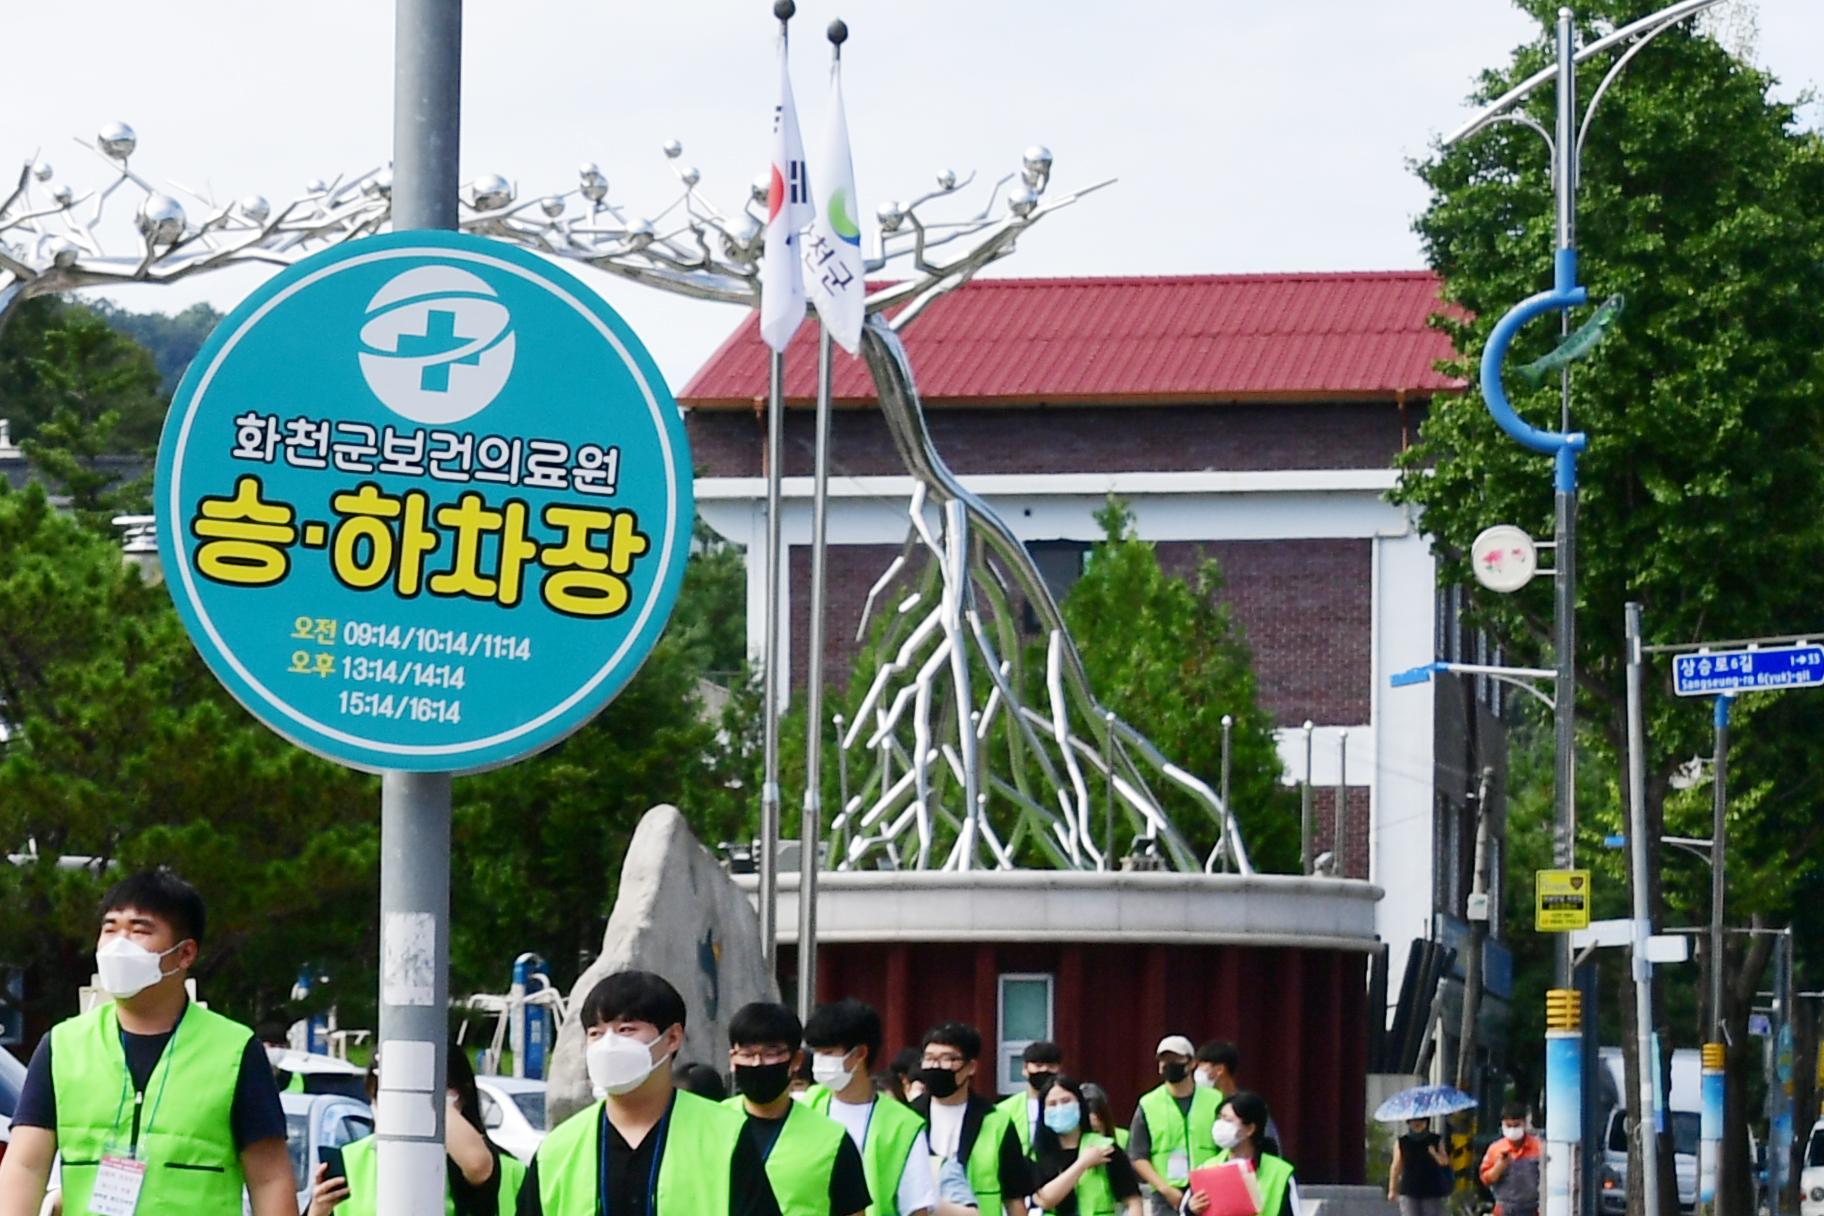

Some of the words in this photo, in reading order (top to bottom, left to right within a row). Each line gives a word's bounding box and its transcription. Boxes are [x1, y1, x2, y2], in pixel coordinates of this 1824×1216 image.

[230, 411, 621, 496] 화천군보건의료원
[191, 474, 648, 618] 승·하차장
[290, 616, 337, 645] 오전
[343, 621, 531, 661] 09:14/10:14/11:14
[287, 650, 336, 678] 오후
[342, 656, 465, 690] 13:14/14:14
[339, 690, 461, 724] 15:14/16:14
